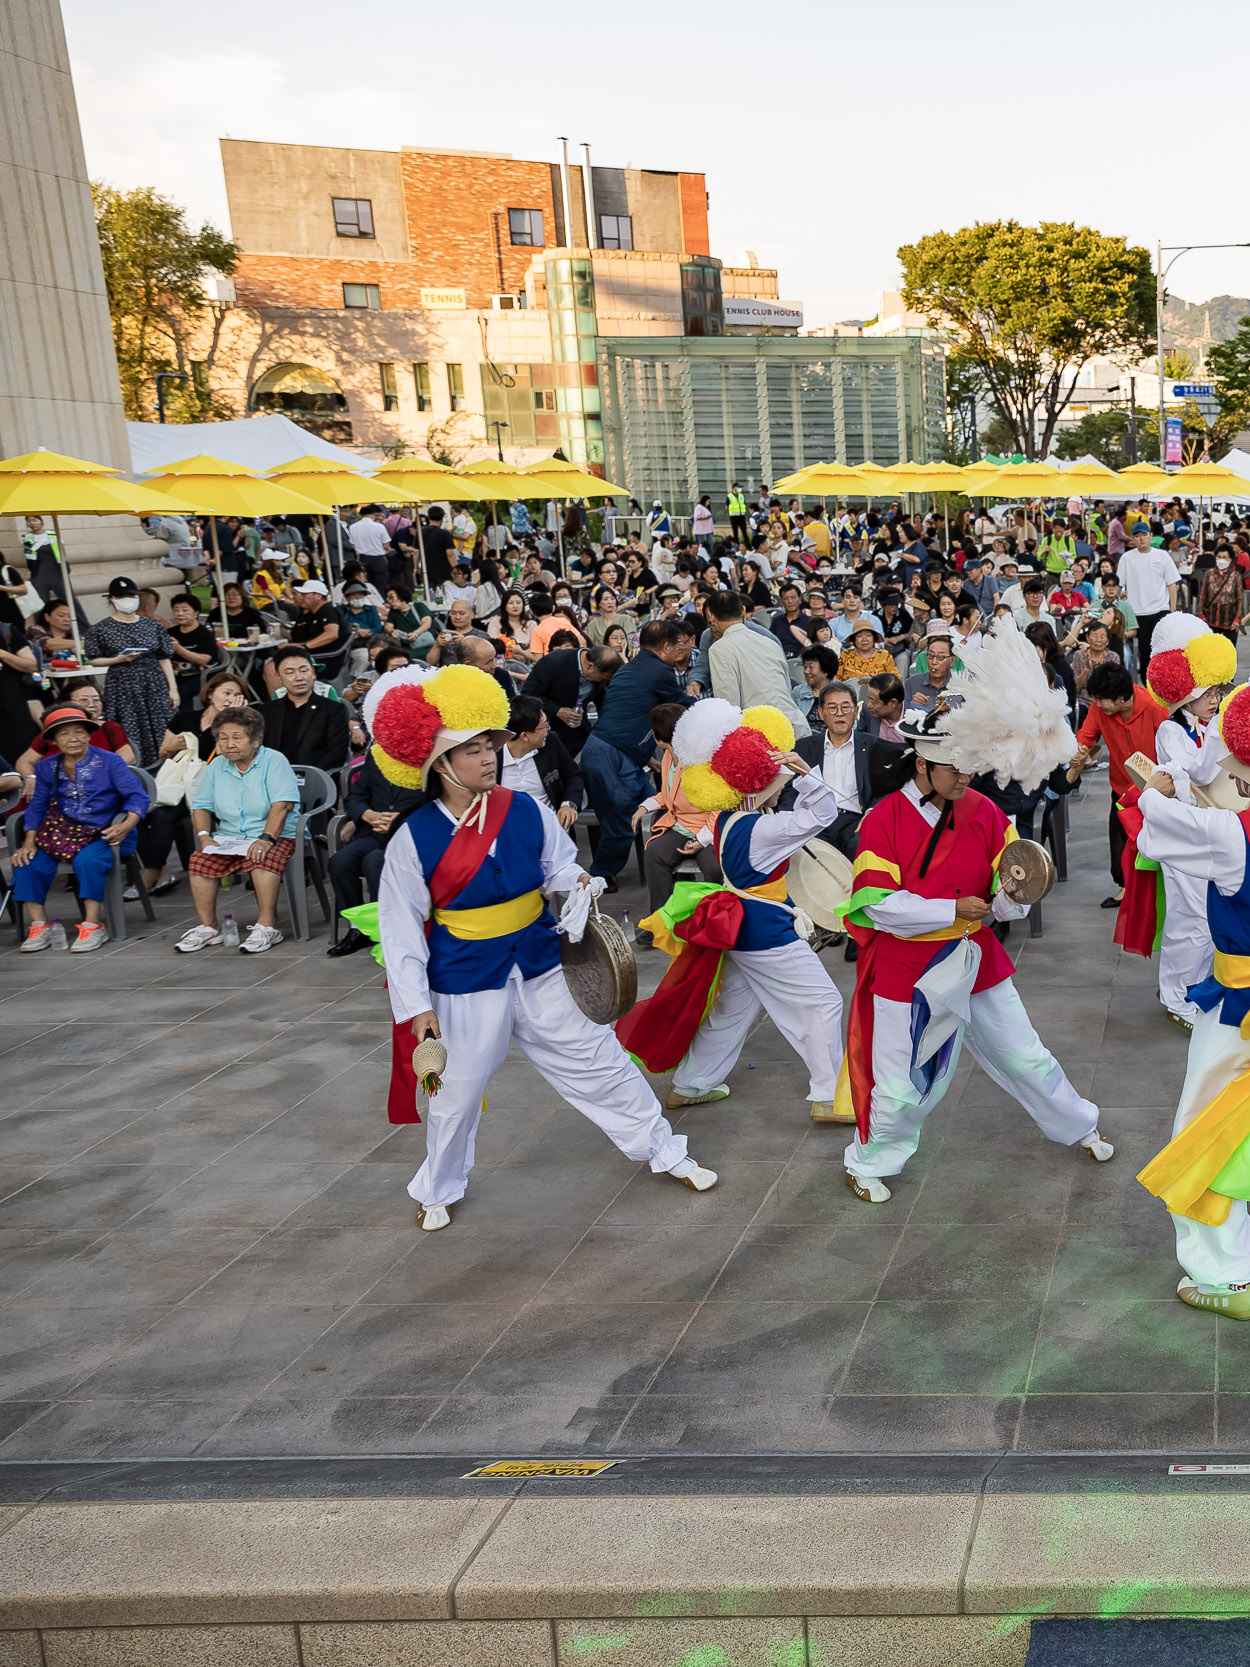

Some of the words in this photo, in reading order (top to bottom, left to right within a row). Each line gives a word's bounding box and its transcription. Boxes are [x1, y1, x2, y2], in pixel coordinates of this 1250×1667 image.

[423, 294, 464, 304] TENNIS
[752, 308, 773, 317] CLUB
[773, 309, 801, 318] HOUSE
[476, 1468, 591, 1477] WARNING
